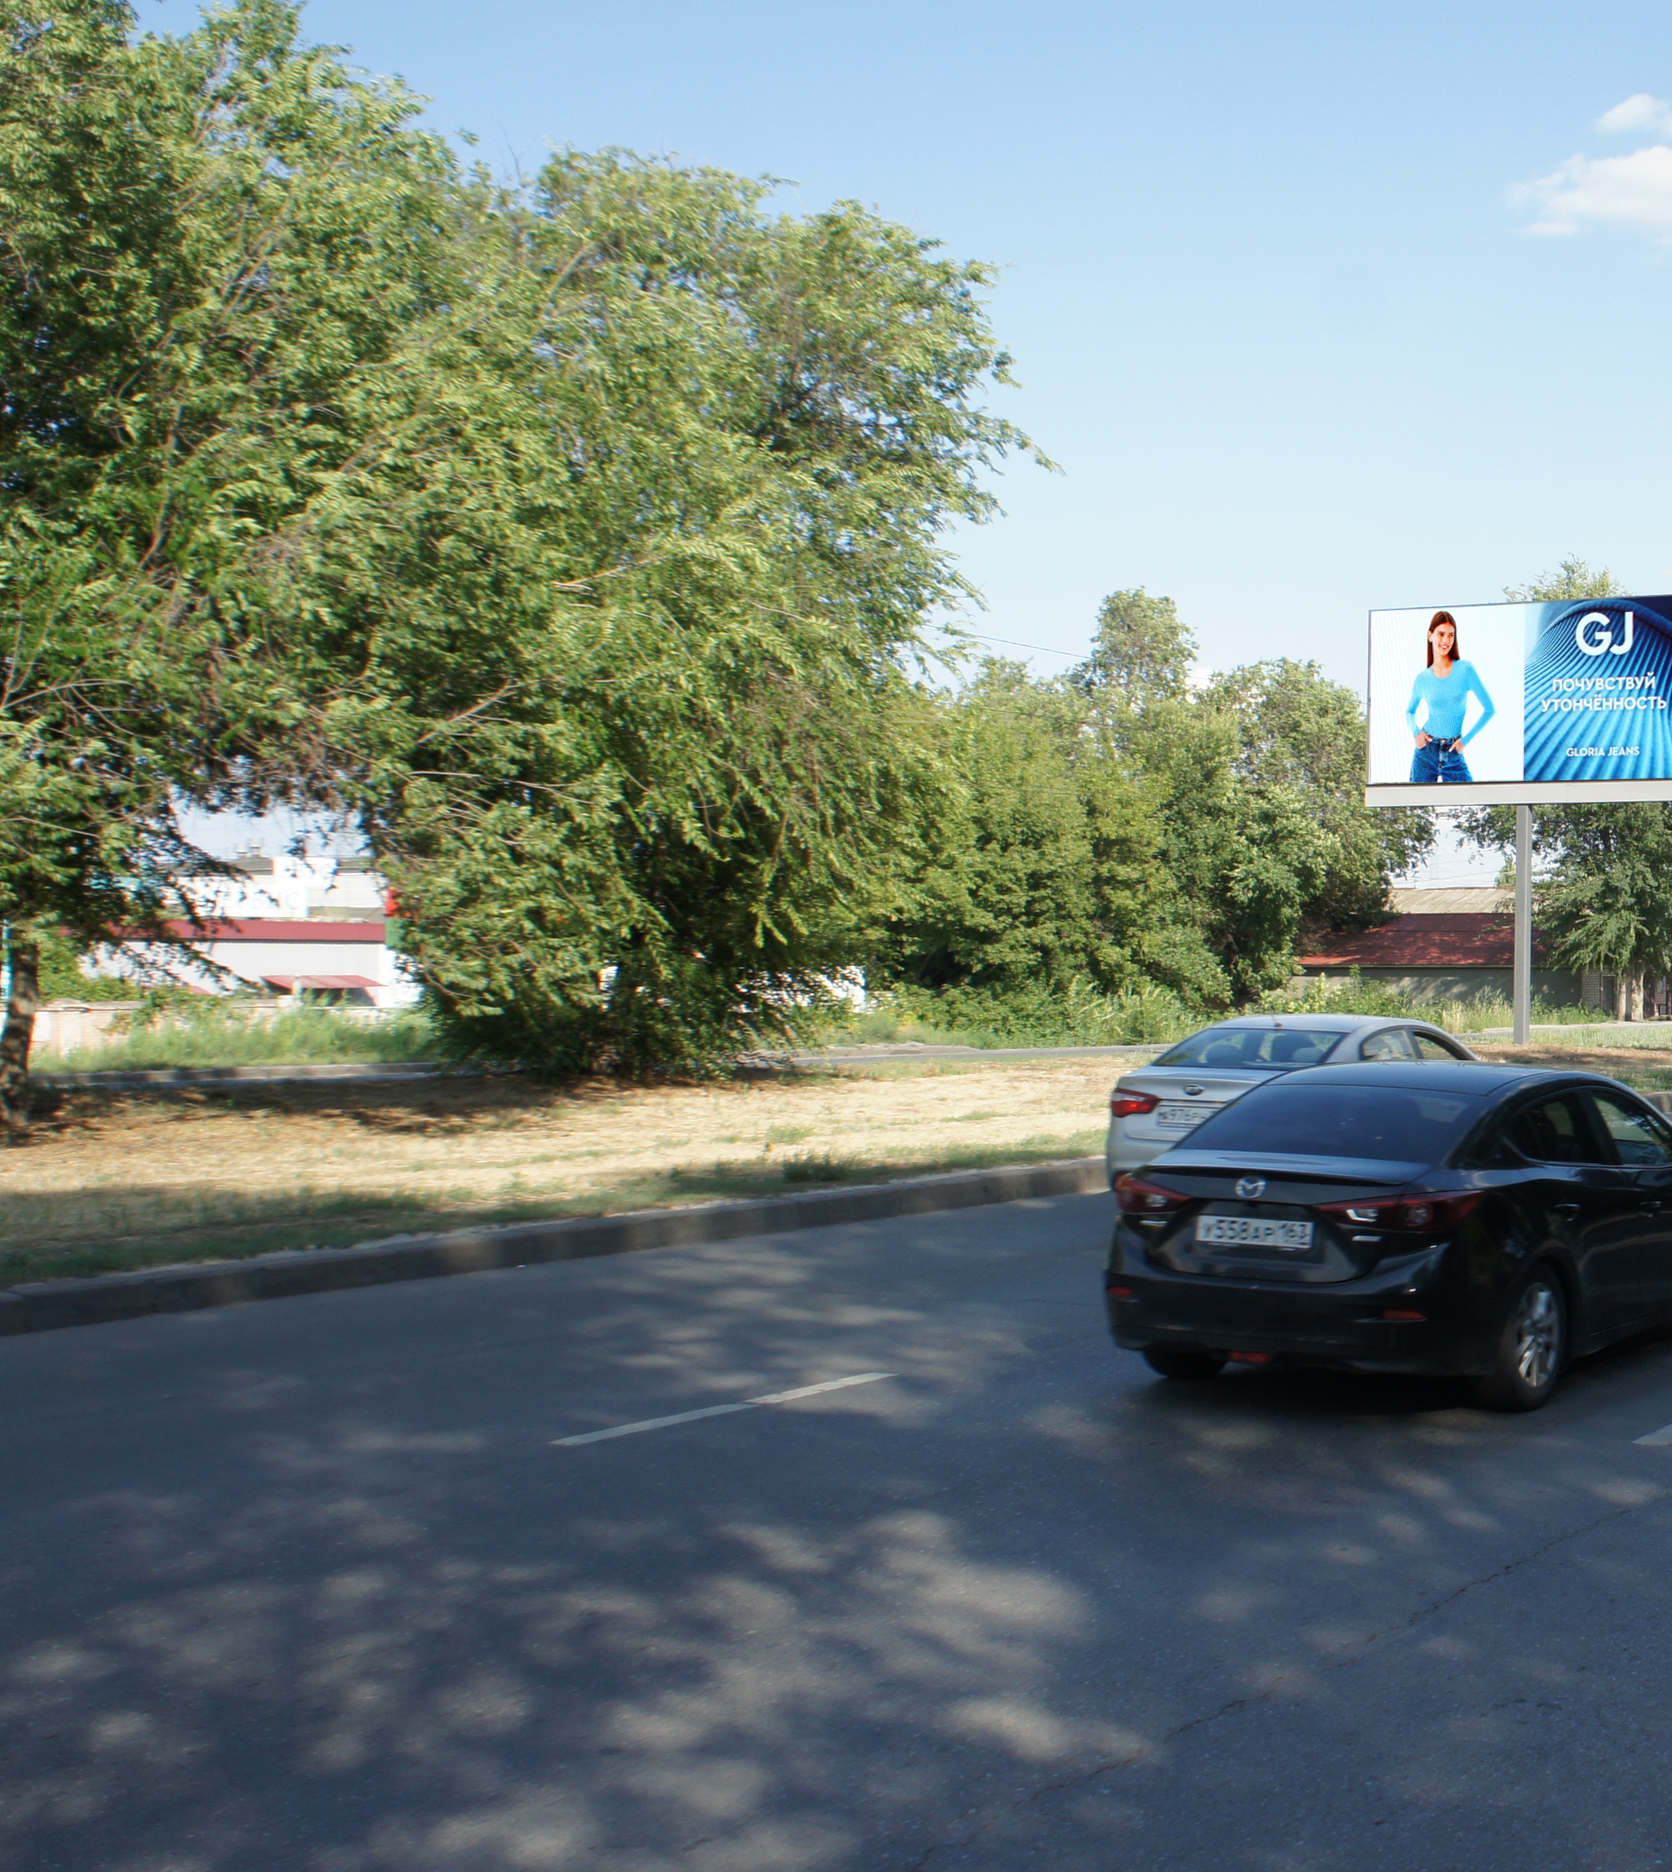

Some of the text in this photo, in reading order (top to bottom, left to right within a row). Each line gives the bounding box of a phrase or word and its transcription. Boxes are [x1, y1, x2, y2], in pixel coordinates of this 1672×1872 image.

[1575, 611, 1634, 656] GJ
[1552, 671, 1656, 691] ПОЧУВСТВУЙ
[1541, 694, 1667, 712] УТОНЧЁННОСТЬ
[1565, 745, 1640, 758] GLORIA JEANS
[1203, 1218, 1275, 1242] У558АР
